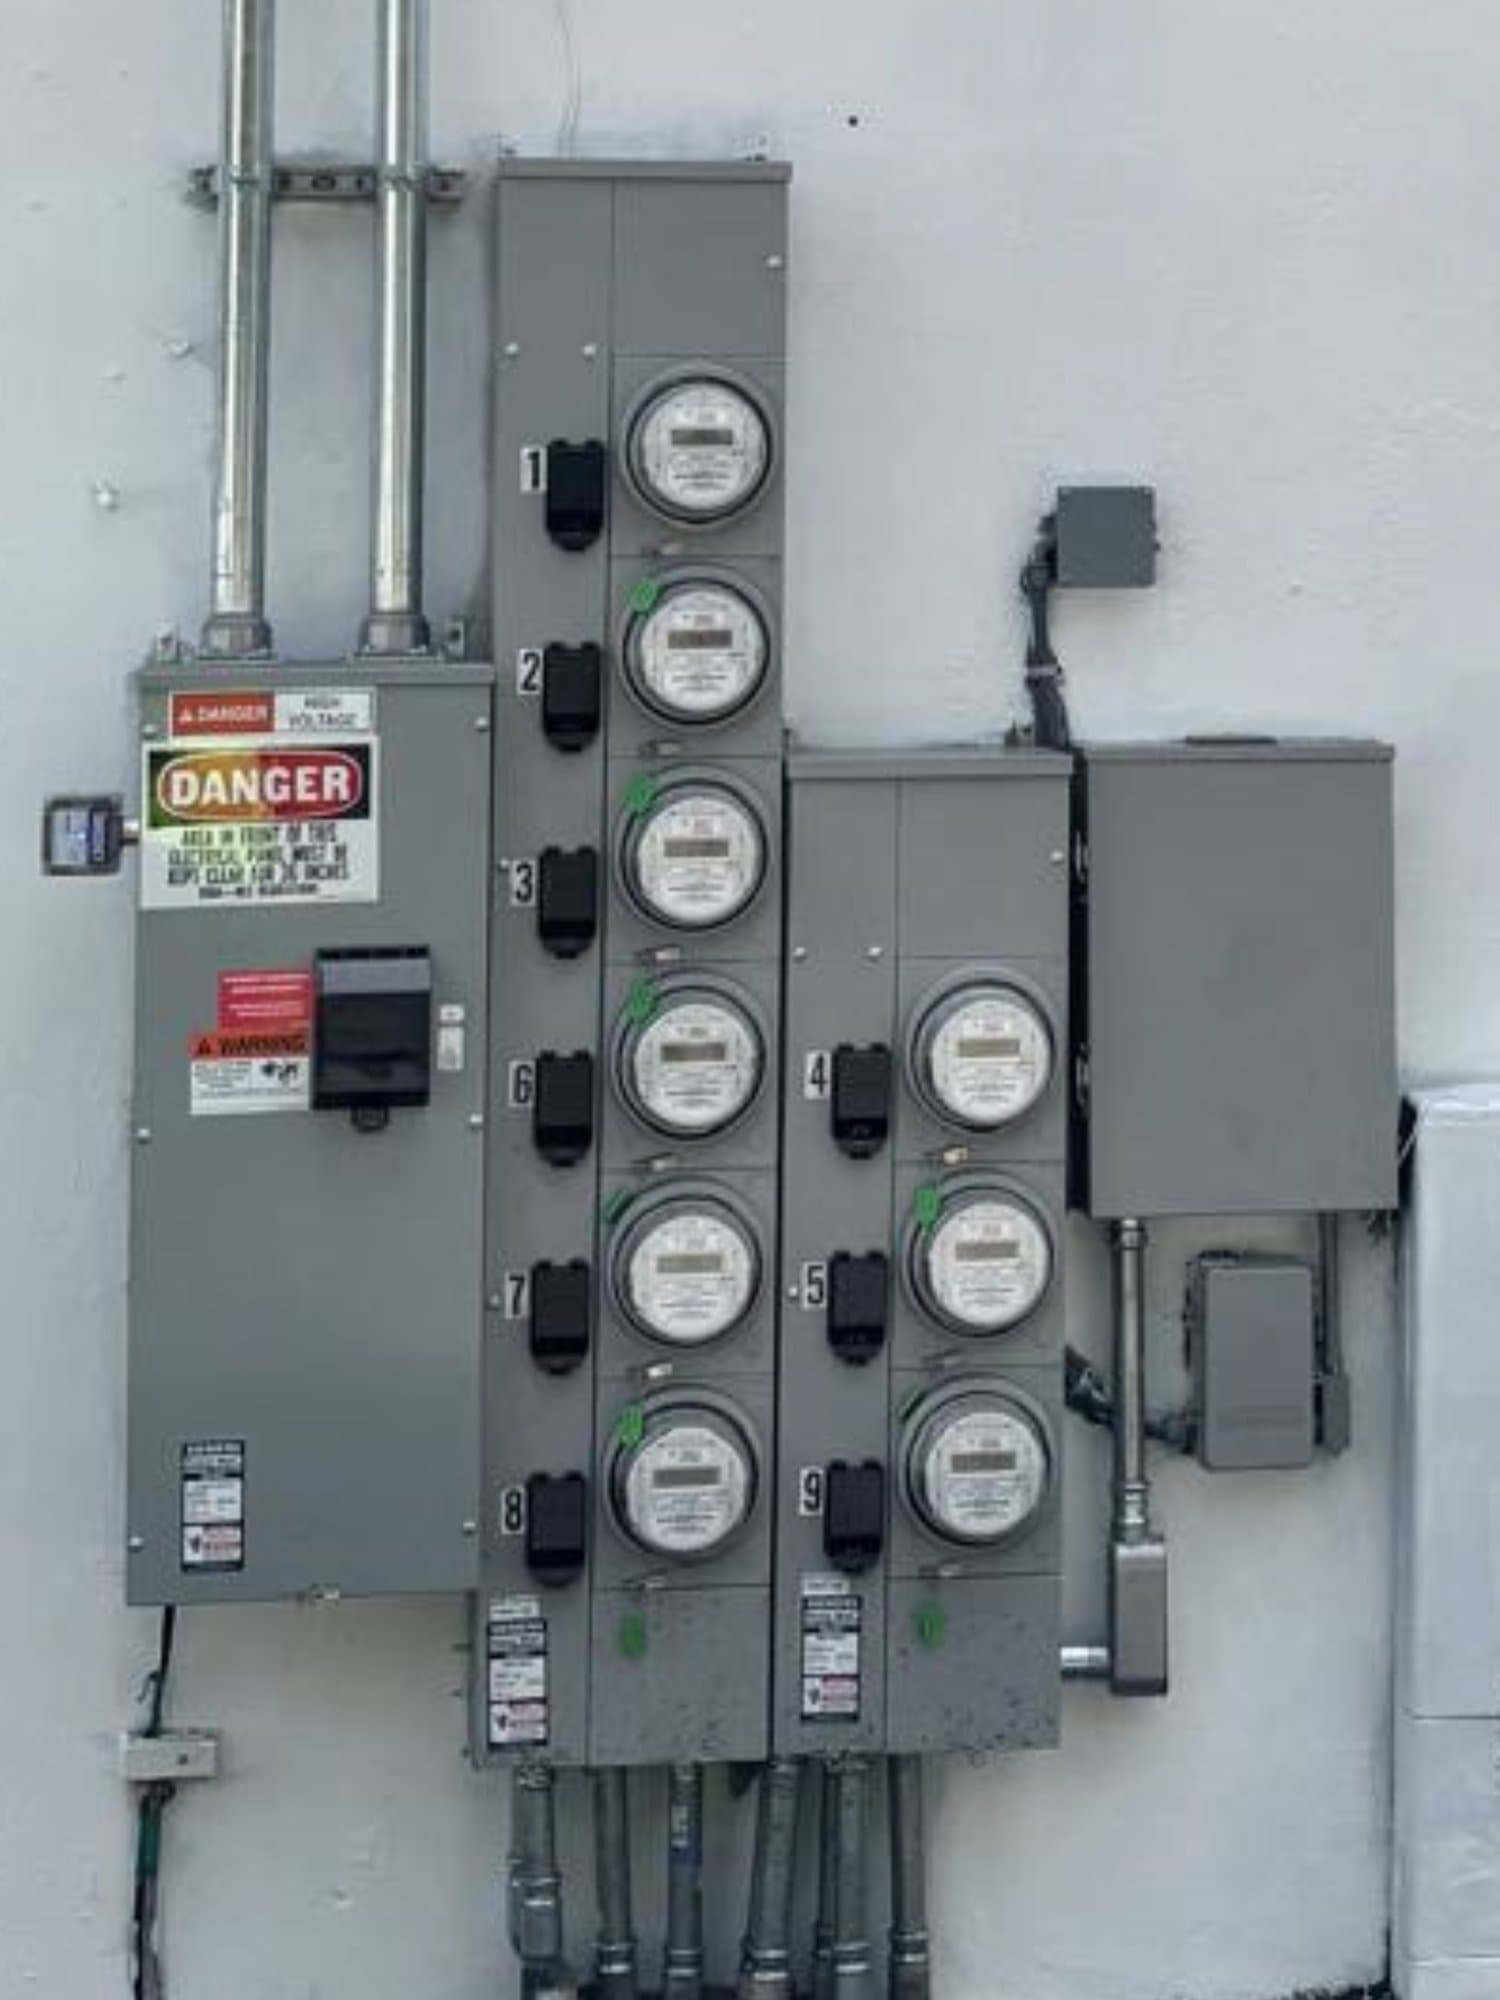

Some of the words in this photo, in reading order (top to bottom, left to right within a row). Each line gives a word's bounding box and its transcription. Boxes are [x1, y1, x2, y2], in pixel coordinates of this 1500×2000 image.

[527, 451, 540, 489] 1
[522, 652, 540, 691] 2
[198, 705, 267, 721] DANGER
[171, 765, 350, 805] DANGER
[515, 863, 533, 902] 3
[220, 1034, 306, 1055] WARNING
[513, 1065, 532, 1104] 6
[810, 1054, 827, 1094] 4
[508, 1275, 525, 1316] 7
[807, 1264, 824, 1304] 5
[504, 1488, 522, 1531] 8
[804, 1472, 820, 1511] 9
